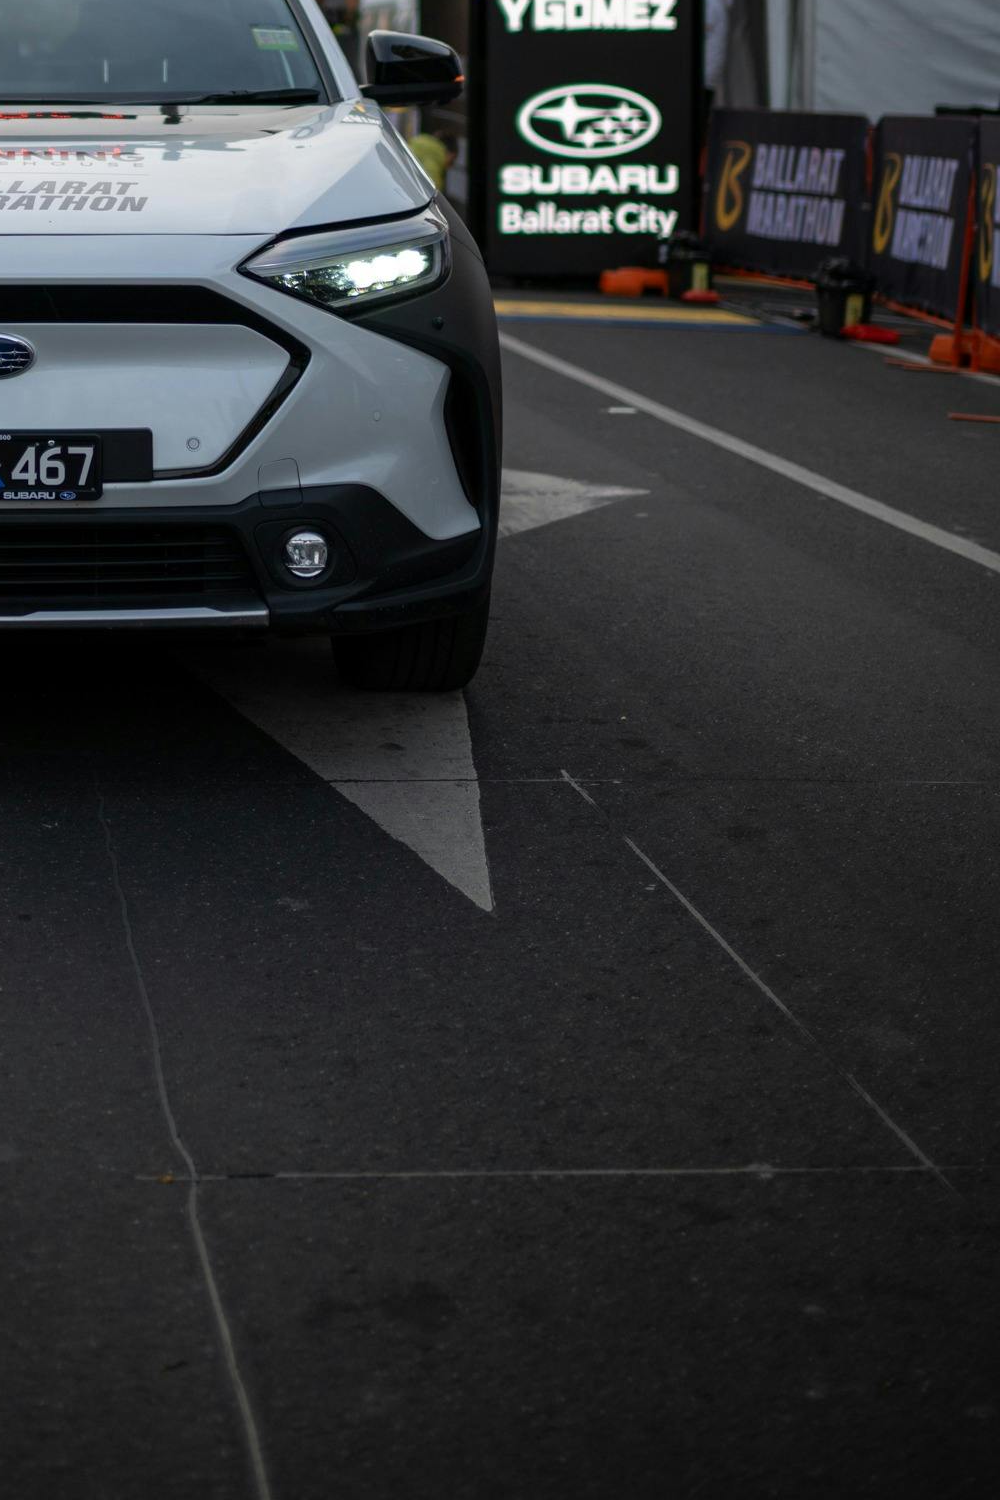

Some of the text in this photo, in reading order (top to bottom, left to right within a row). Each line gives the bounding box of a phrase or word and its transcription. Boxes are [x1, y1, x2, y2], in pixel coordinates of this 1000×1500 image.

[499, 164, 679, 195] SUBARU
[752, 142, 846, 196] BALLARAT
[499, 201, 678, 239] Ballarat City
[745, 189, 846, 248] MARATHON
[11, 446, 95, 486] 467
[3, 491, 56, 500] SUBARU
